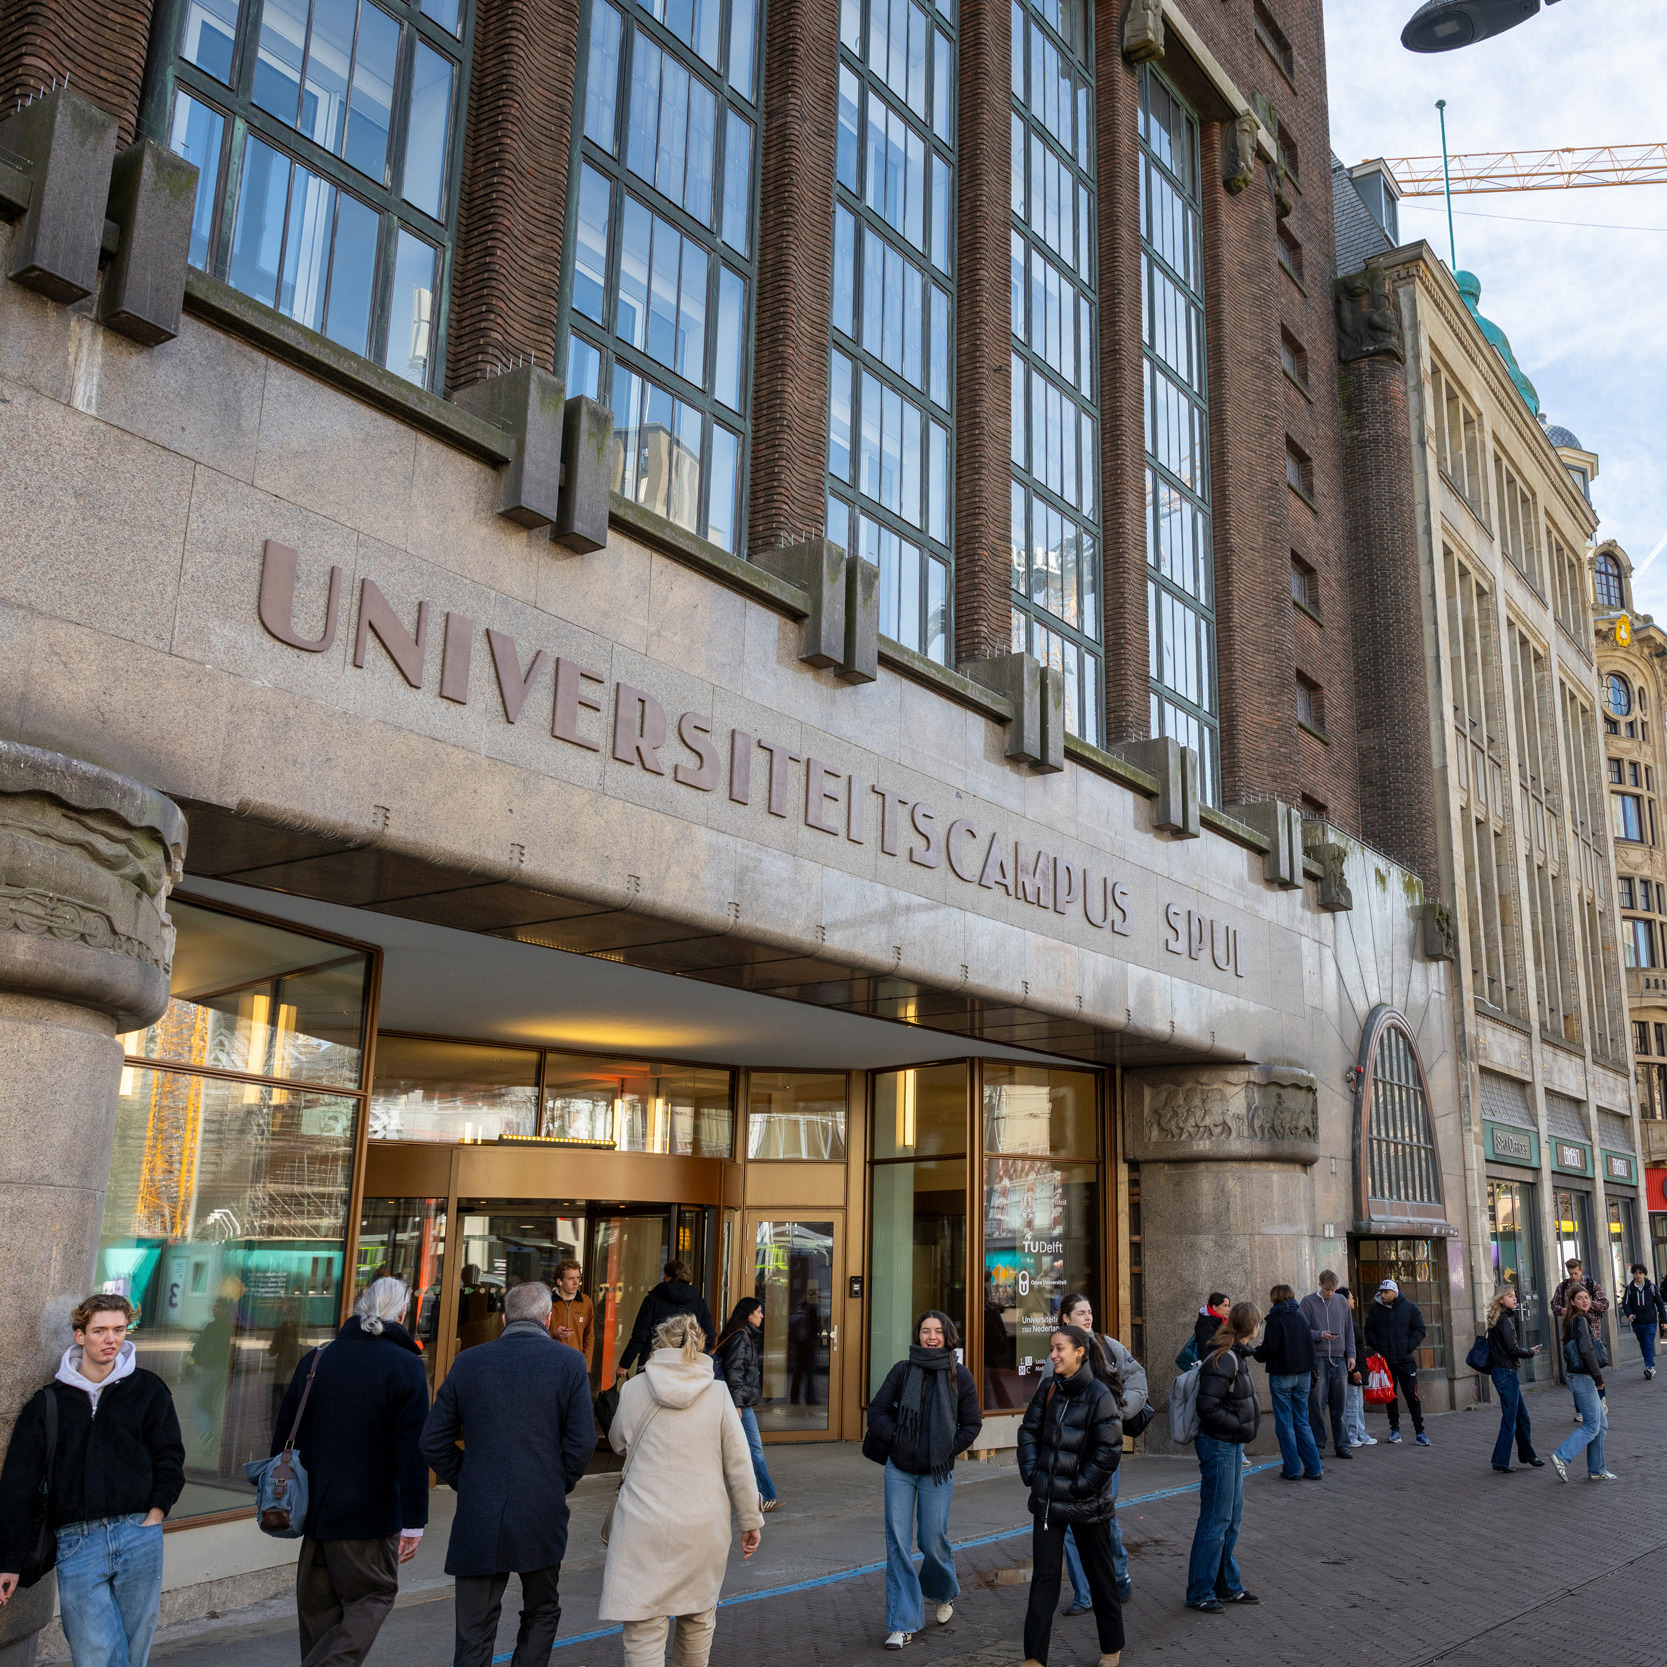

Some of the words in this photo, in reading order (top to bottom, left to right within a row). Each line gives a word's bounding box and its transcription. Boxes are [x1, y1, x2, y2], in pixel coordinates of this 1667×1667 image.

[258, 539, 1135, 937] UNIVERSITEITSCAMPUS
[1165, 902, 1244, 978] SPUI
[1040, 1241, 1063, 1253] Delft
